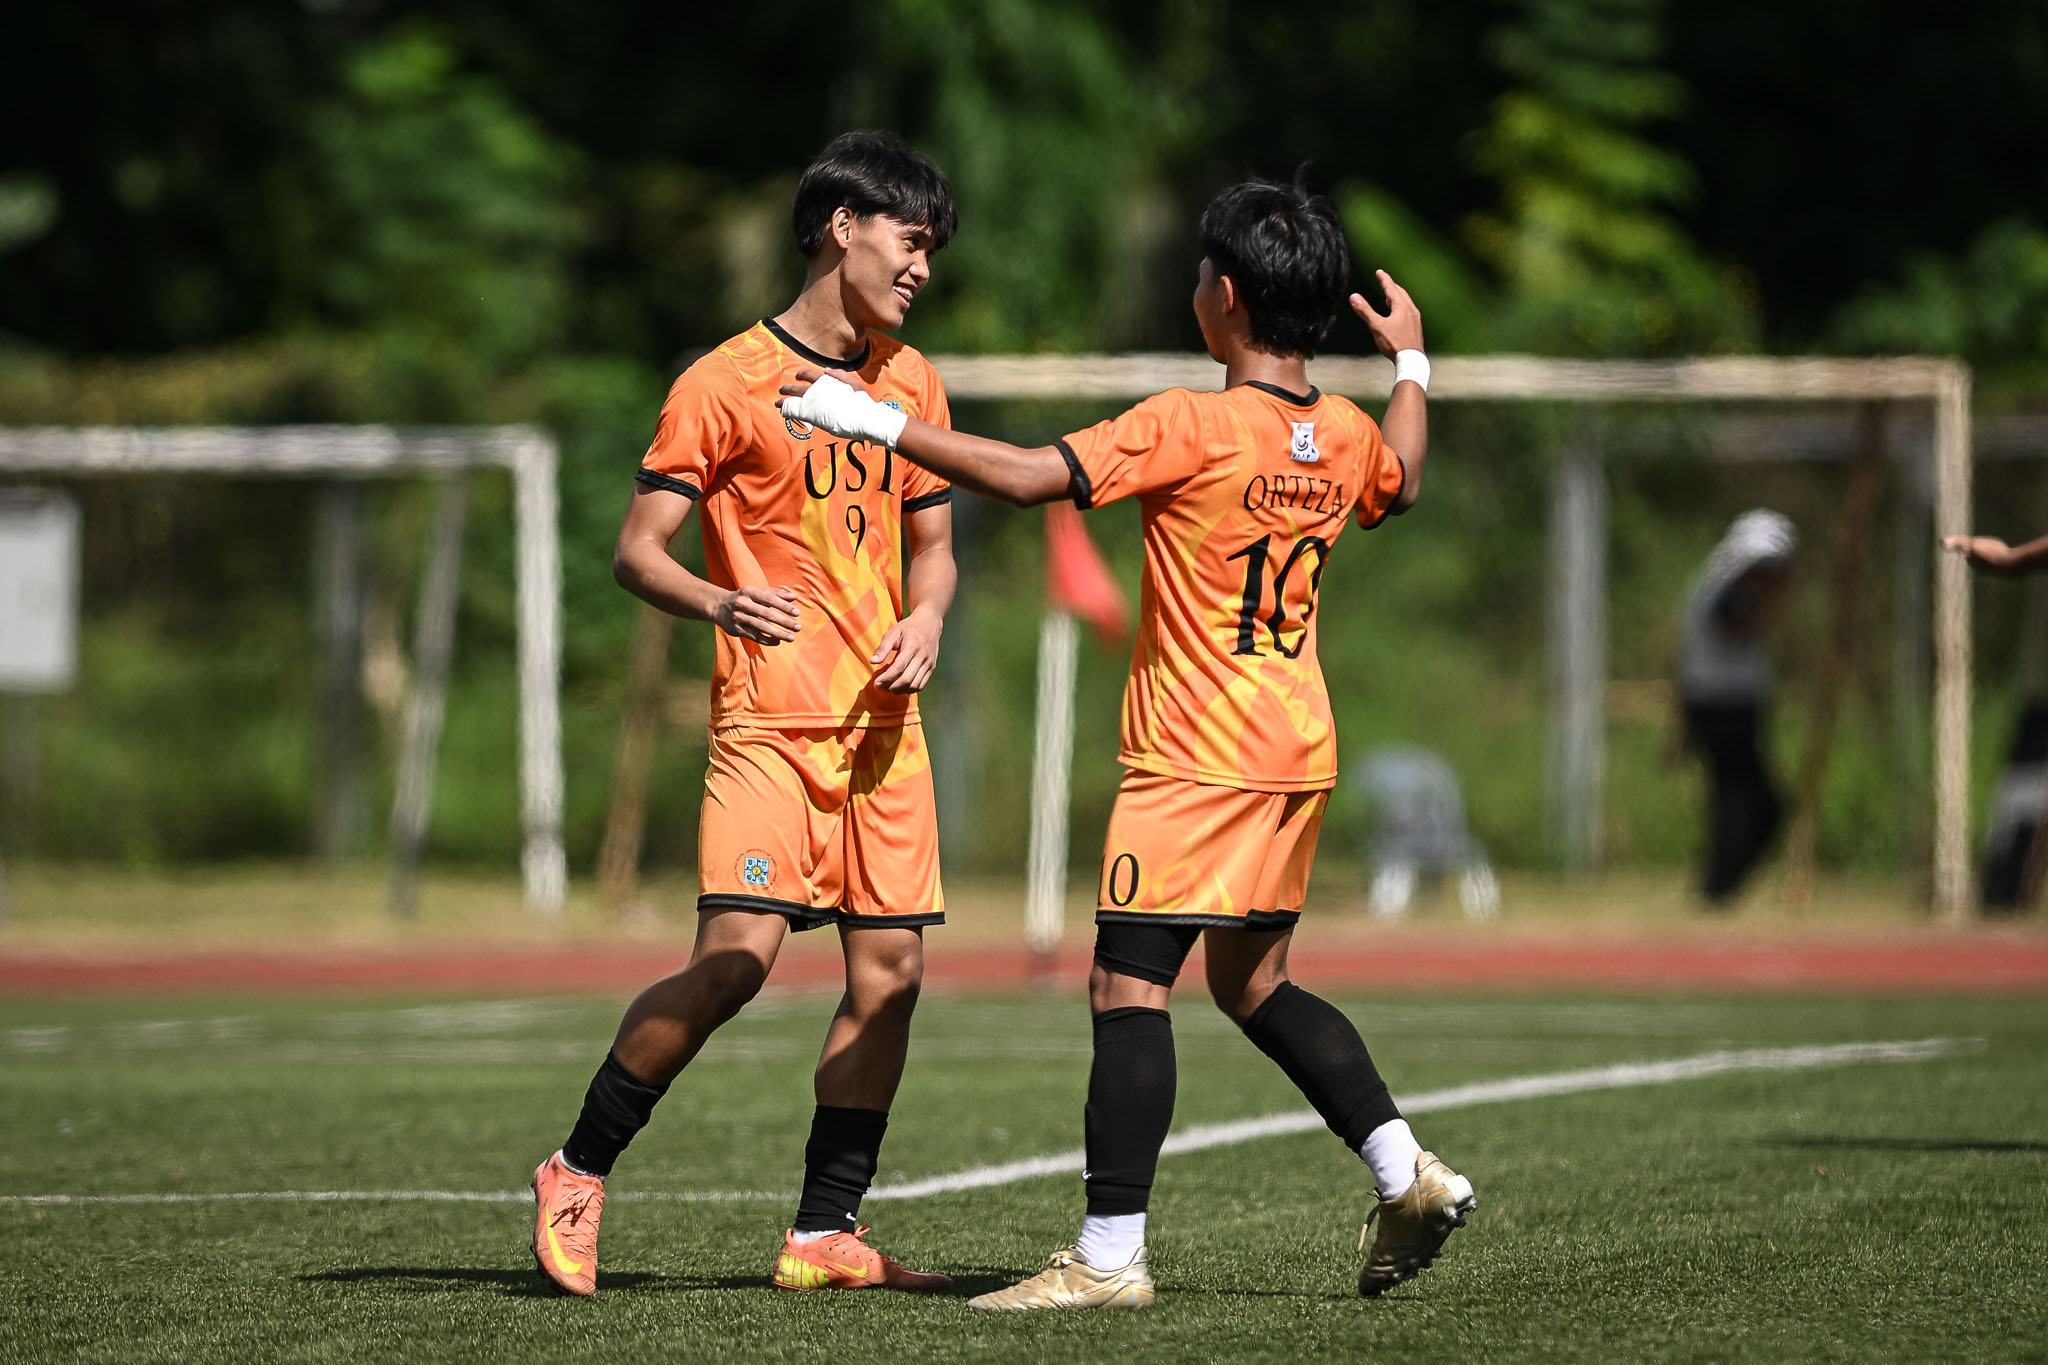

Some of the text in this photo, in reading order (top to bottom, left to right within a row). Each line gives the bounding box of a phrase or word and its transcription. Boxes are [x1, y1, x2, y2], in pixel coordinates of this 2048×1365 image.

[803, 440, 895, 499] UST
[1243, 474, 1344, 519] ORTEZA
[845, 504, 866, 559] 9
[1226, 533, 1330, 659] 10
[1098, 853, 1140, 907] 0
[775, 1250, 830, 1289] NIKE
